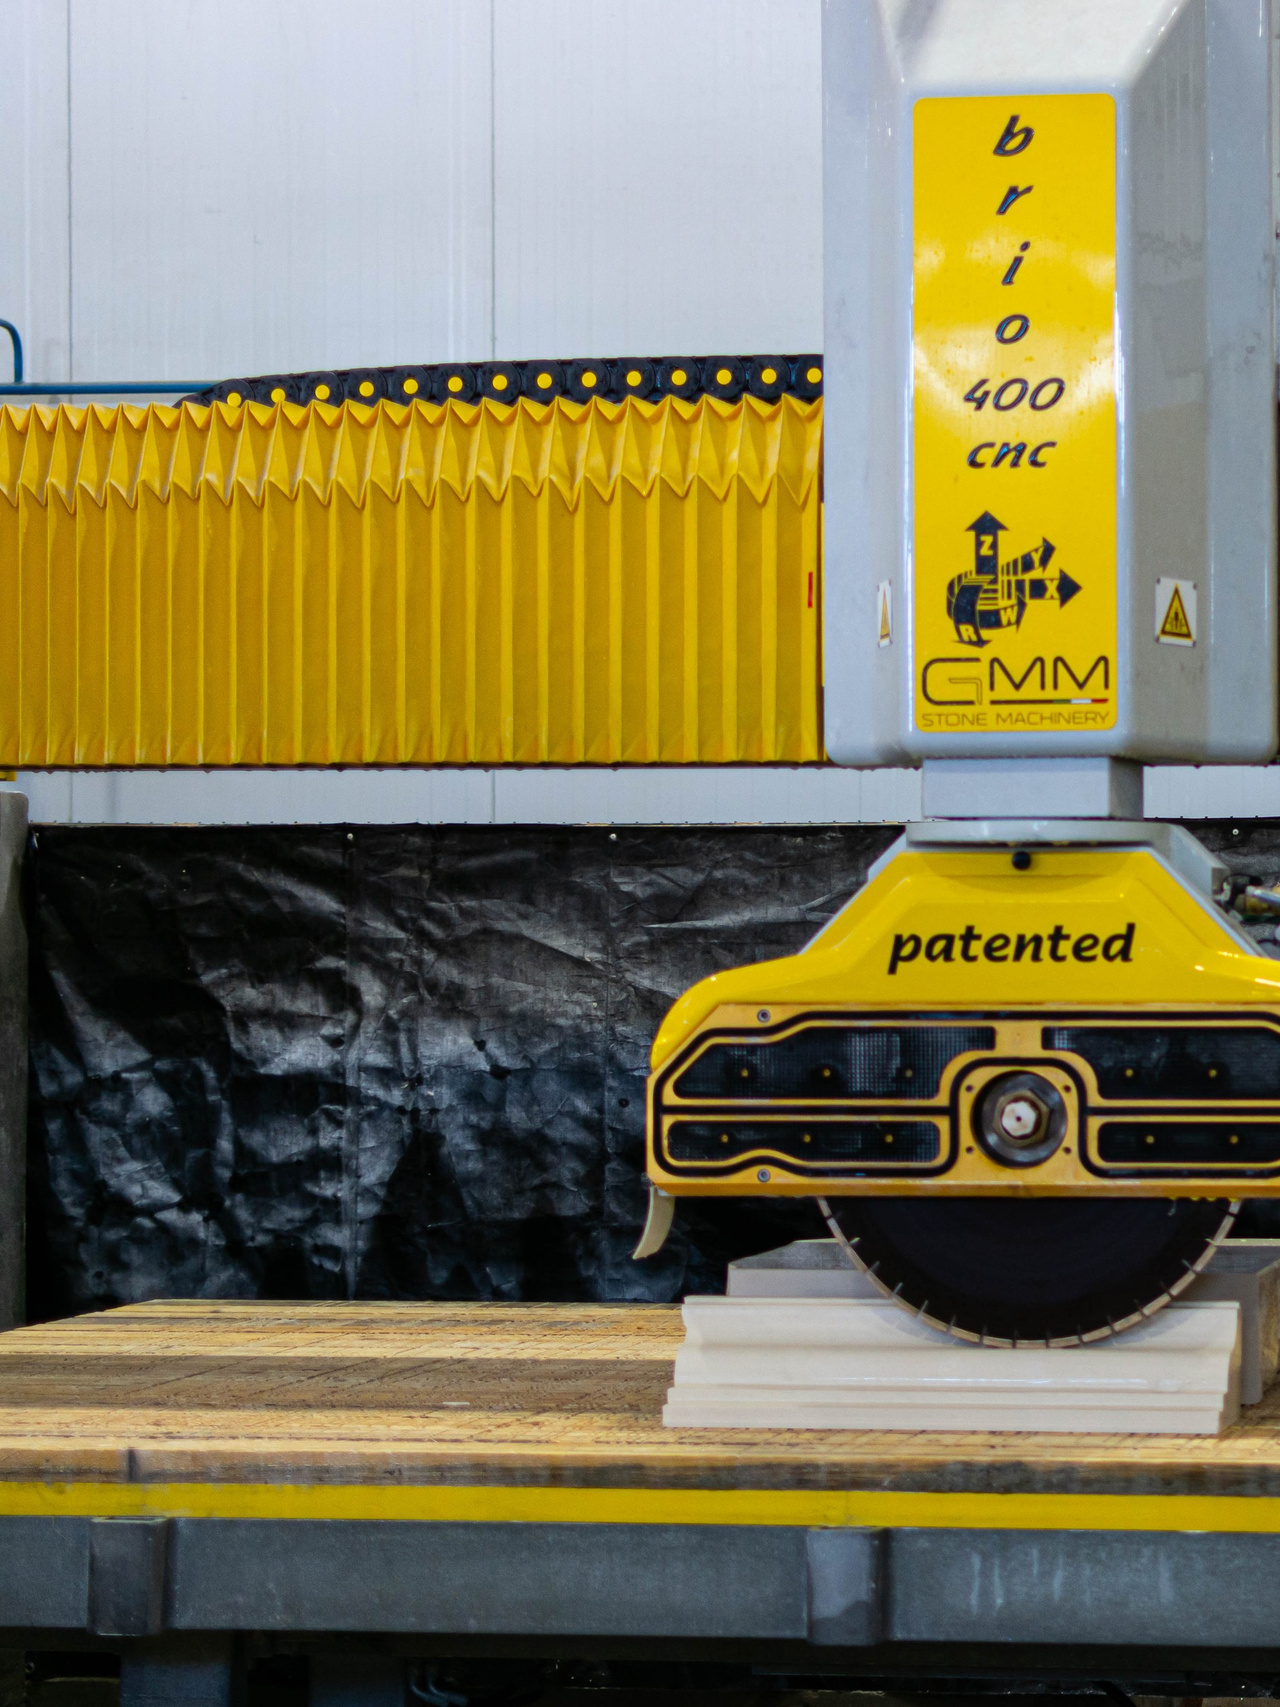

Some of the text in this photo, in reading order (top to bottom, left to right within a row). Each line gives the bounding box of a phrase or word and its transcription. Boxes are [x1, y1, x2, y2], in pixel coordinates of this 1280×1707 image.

[993, 115, 1035, 346] brio
[963, 377, 1066, 411] 400
[966, 441, 1058, 469] cnc
[979, 535, 994, 556] Z
[1030, 546, 1045, 569] Y
[1044, 578, 1060, 600] X
[1000, 605, 1018, 627] W
[958, 624, 978, 642] R
[921, 655, 1110, 706] GMM
[922, 711, 1110, 727] STONE MACHINERY
[887, 922, 1136, 976] patented
